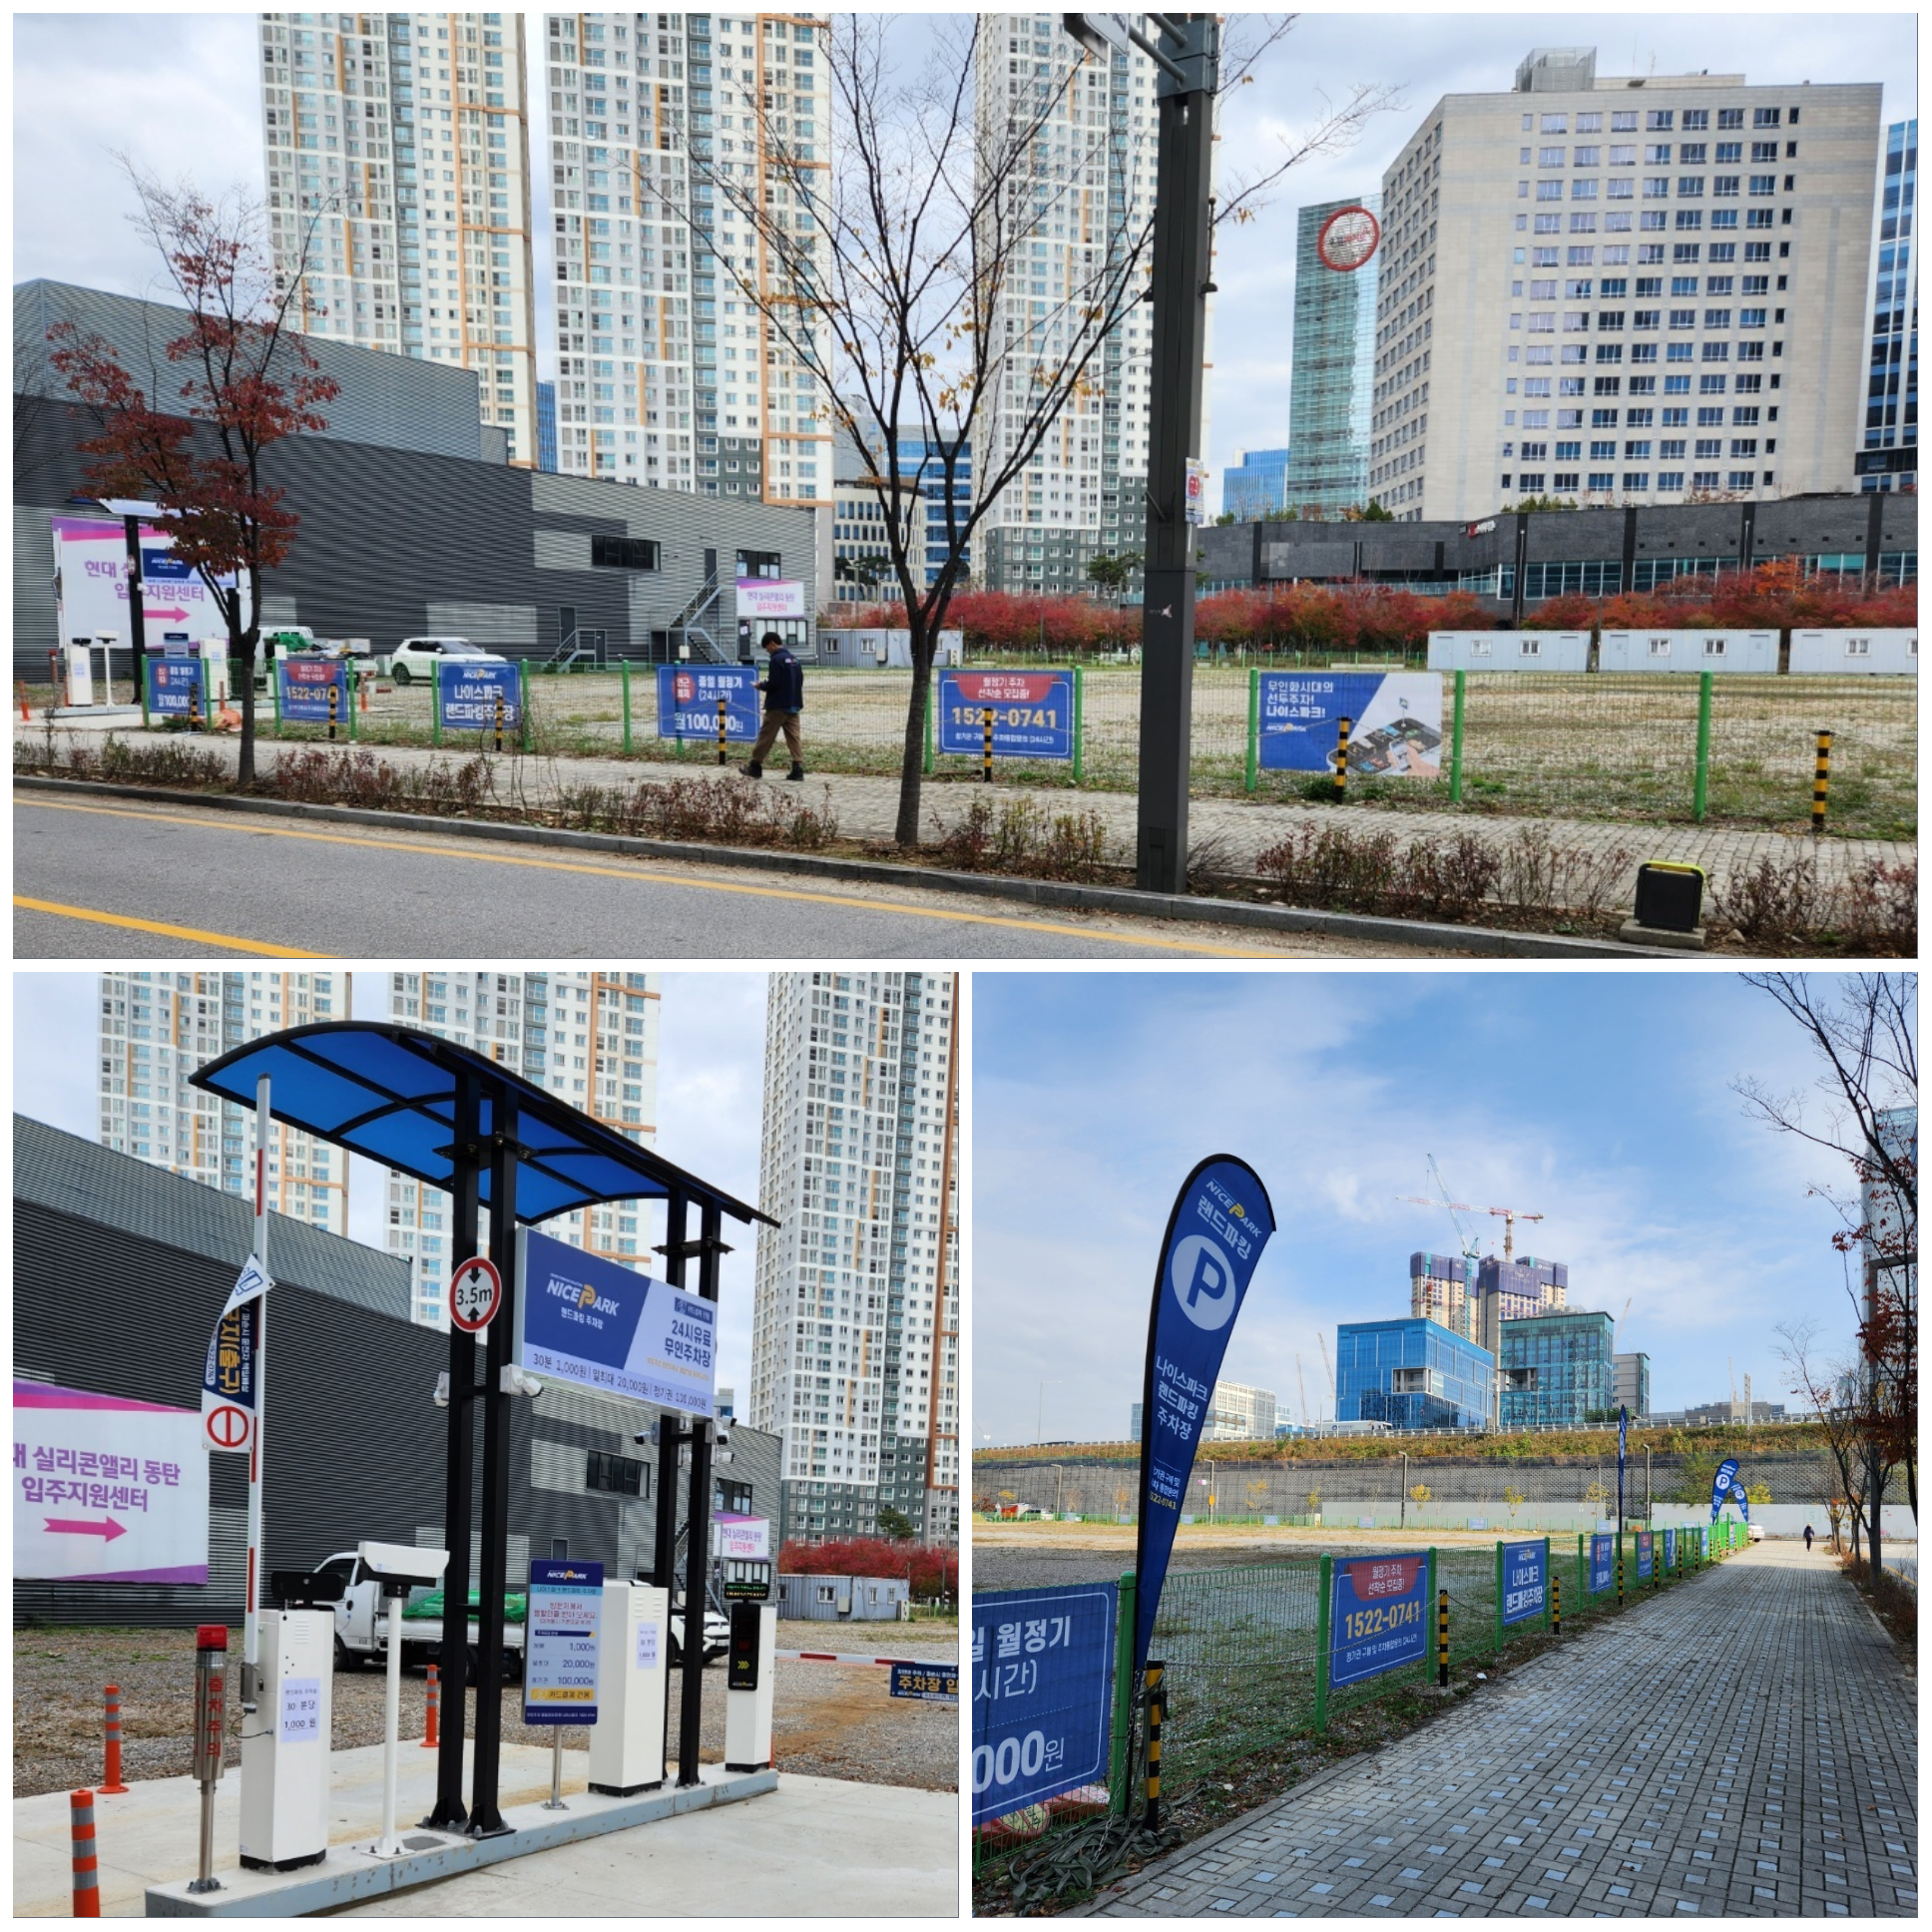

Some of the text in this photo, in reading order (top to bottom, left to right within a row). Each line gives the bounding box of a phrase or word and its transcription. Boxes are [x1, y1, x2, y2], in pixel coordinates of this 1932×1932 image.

[84, 560, 118, 579] 현대
[114, 583, 205, 602] 입지원센터
[454, 684, 503, 700] 나이스파크
[1267, 681, 1334, 694] 무인화시대의
[1267, 694, 1314, 705] 선두주자!
[1266, 707, 1326, 719] 나이스파크!
[1206, 1181, 1262, 1238] NICEPARK
[1197, 1195, 1252, 1260] 랜드파킹
[456, 1286, 493, 1306] 3.5m
[546, 1278, 620, 1317] NICEPARK
[672, 1319, 712, 1347] 24시유료
[533, 1353, 552, 1370] 30분
[665, 1337, 711, 1368] 무인주차장
[1156, 1355, 1208, 1401] 나이스파크
[1158, 1380, 1200, 1420] 랜드파킹
[1157, 1406, 1193, 1440] 주차장
[32, 1446, 139, 1482] 실리콘앨리
[143, 1459, 181, 1487] 동탄
[21, 1476, 149, 1513] 입주지원센터
[1391, 1564, 1402, 1576] 주차
[1345, 1601, 1420, 1640] 1522-0741
[997, 1615, 1071, 1659] 월정기
[898, 1675, 942, 1692] 주차장
[206, 1676, 224, 1758] 출차주의
[284, 1719, 306, 1730] 1,000
